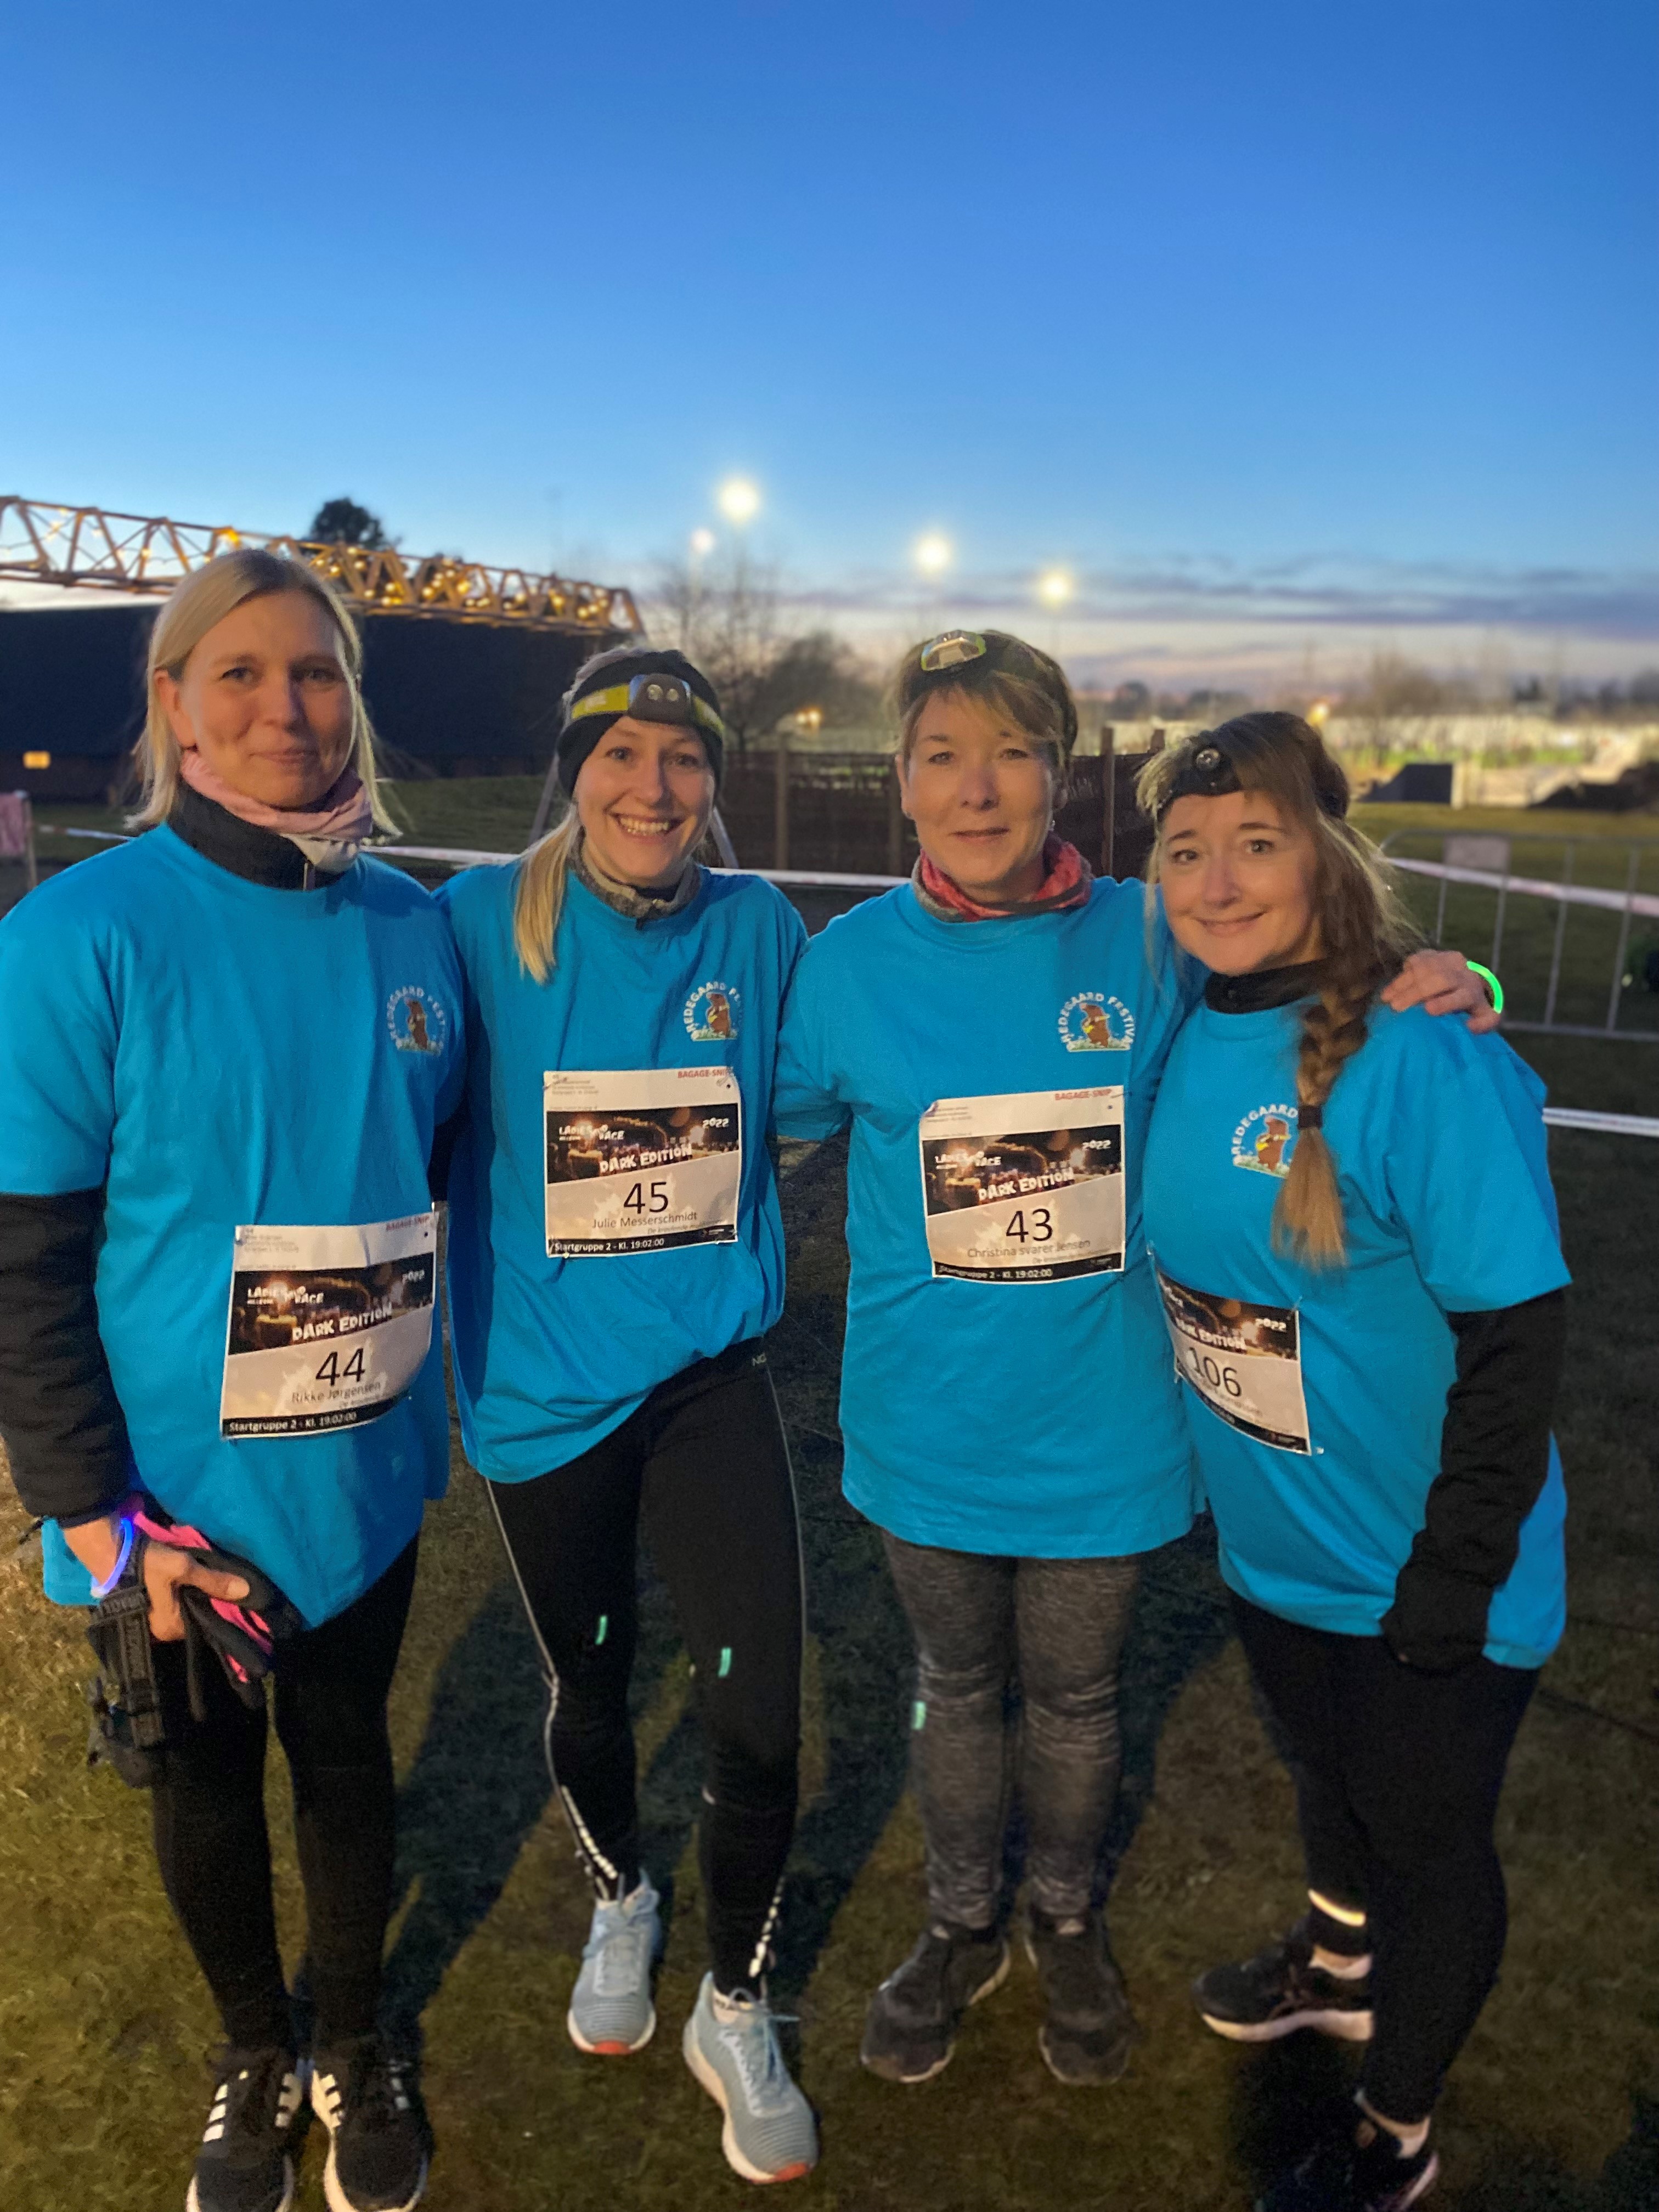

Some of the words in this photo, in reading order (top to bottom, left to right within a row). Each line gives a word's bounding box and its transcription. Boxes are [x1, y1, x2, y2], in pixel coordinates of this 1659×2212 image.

[702, 1118, 729, 1129] 2022
[599, 1154, 637, 1173] DARK
[640, 1143, 692, 1166] EDITION
[1082, 1139, 1111, 1151] 2022
[623, 1181, 669, 1214] 45
[978, 1181, 1017, 1200] DARK
[1018, 1166, 1075, 1193] EDITION
[592, 1218, 617, 1228] Julie
[620, 1211, 698, 1227] Messerschmidt
[1006, 1208, 1053, 1243] 43
[606, 1242, 611, 1251] 2
[292, 1319, 335, 1341] DARK
[339, 1301, 392, 1332] EDITION
[1255, 1318, 1287, 1333] 2022
[315, 1347, 366, 1387] 44
[1189, 1346, 1242, 1397] 106
[290, 1419, 297, 1430] 2
